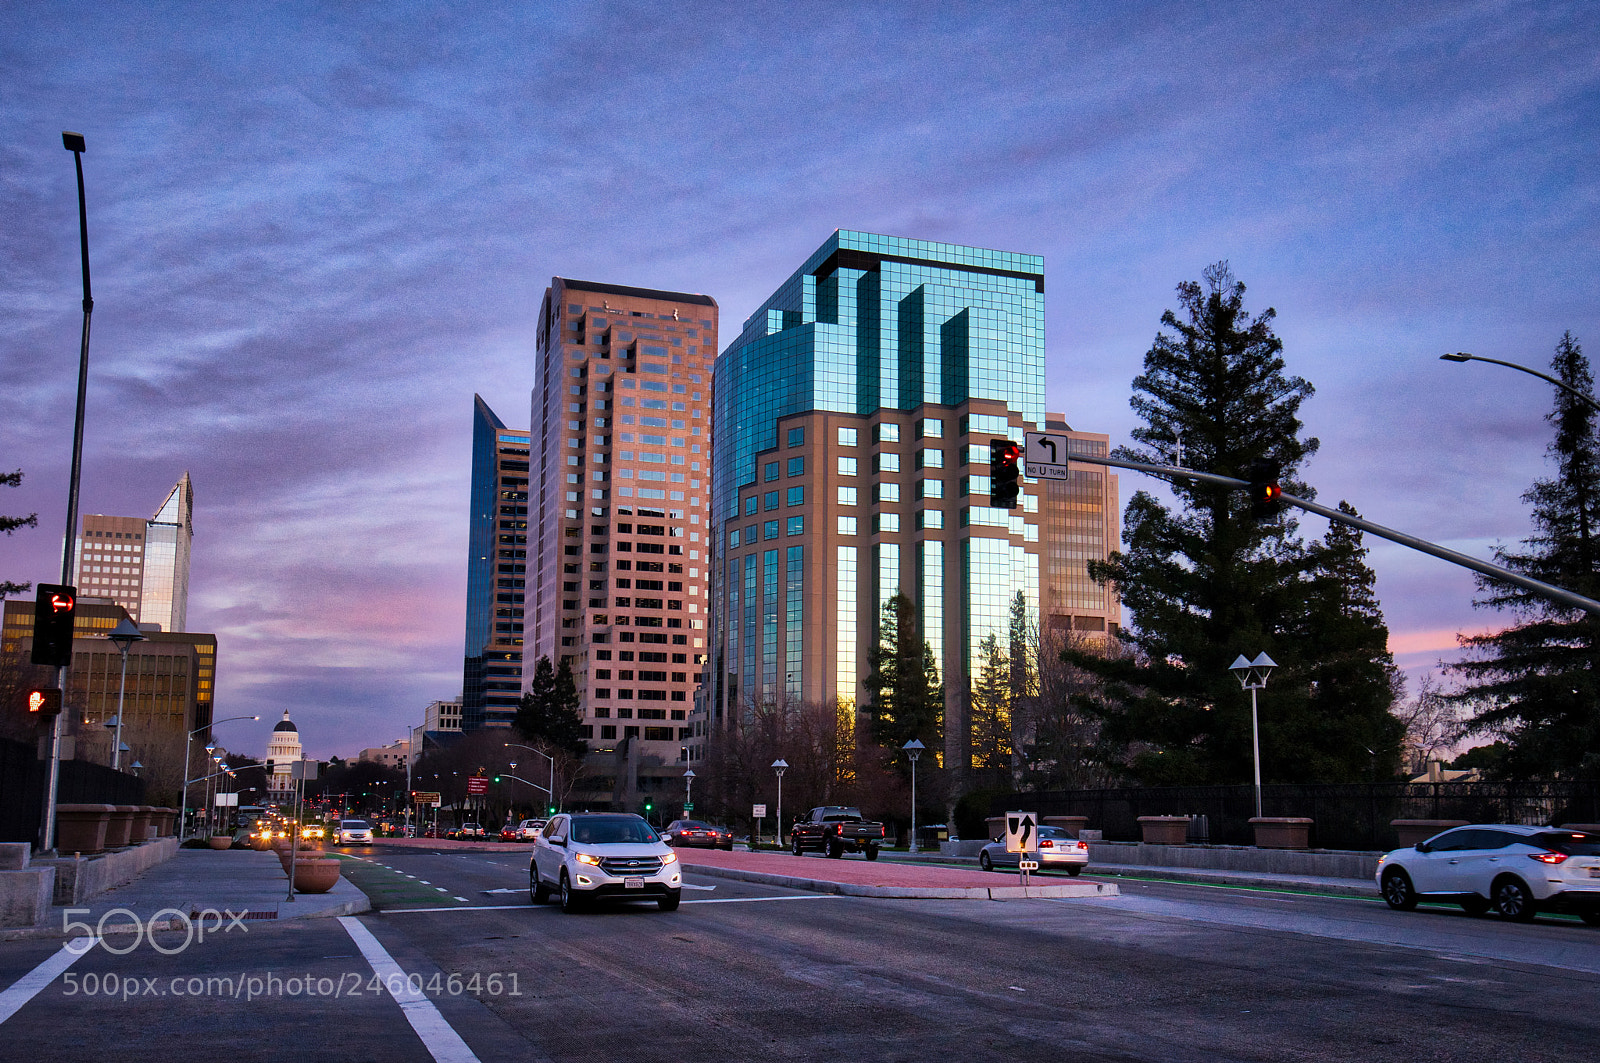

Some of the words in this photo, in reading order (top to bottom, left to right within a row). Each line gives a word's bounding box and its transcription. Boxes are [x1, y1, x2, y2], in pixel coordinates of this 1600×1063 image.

[1027, 466, 1036, 474] NO
[1039, 466, 1047, 476] U
[1049, 468, 1066, 476] TURN
